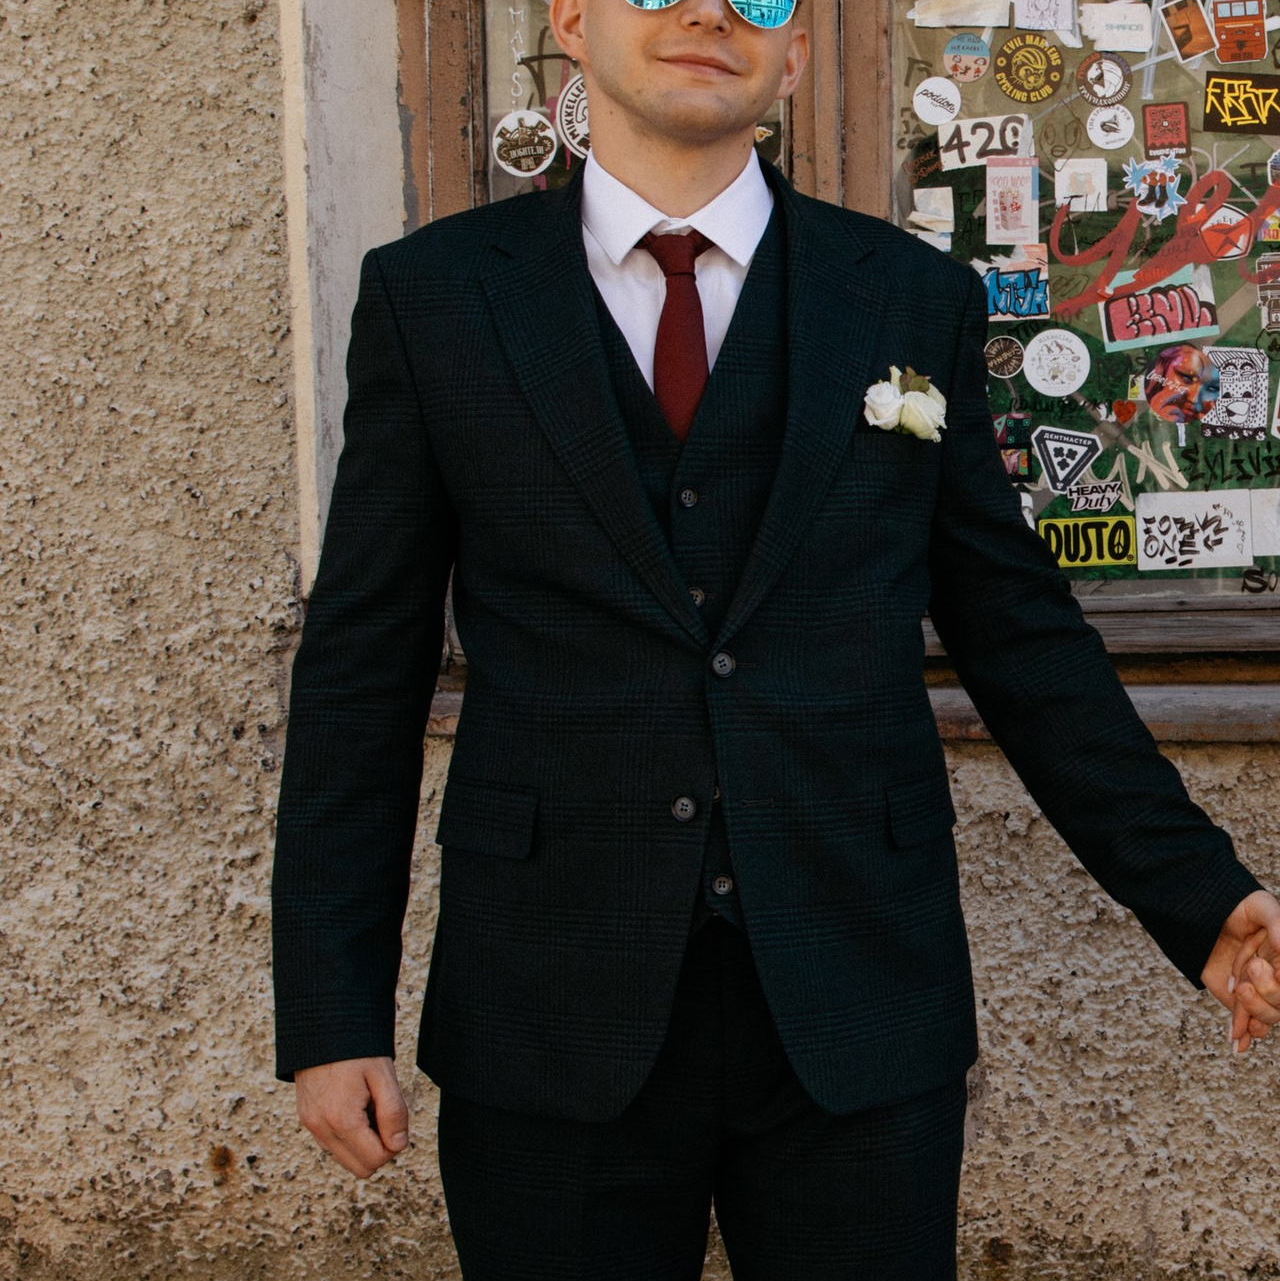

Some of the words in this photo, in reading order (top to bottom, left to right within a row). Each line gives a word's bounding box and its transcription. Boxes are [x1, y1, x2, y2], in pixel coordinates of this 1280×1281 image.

[1002, 37, 1024, 55] EVIL
[1025, 34, 1062, 66] MARENS
[995, 72, 1028, 102] CYCLING
[1030, 84, 1053, 102] CLUB
[1043, 432, 1093, 447] ДЕНТМАСТЕР
[1068, 482, 1118, 497] HEAVY
[1073, 494, 1116, 511] Duty
